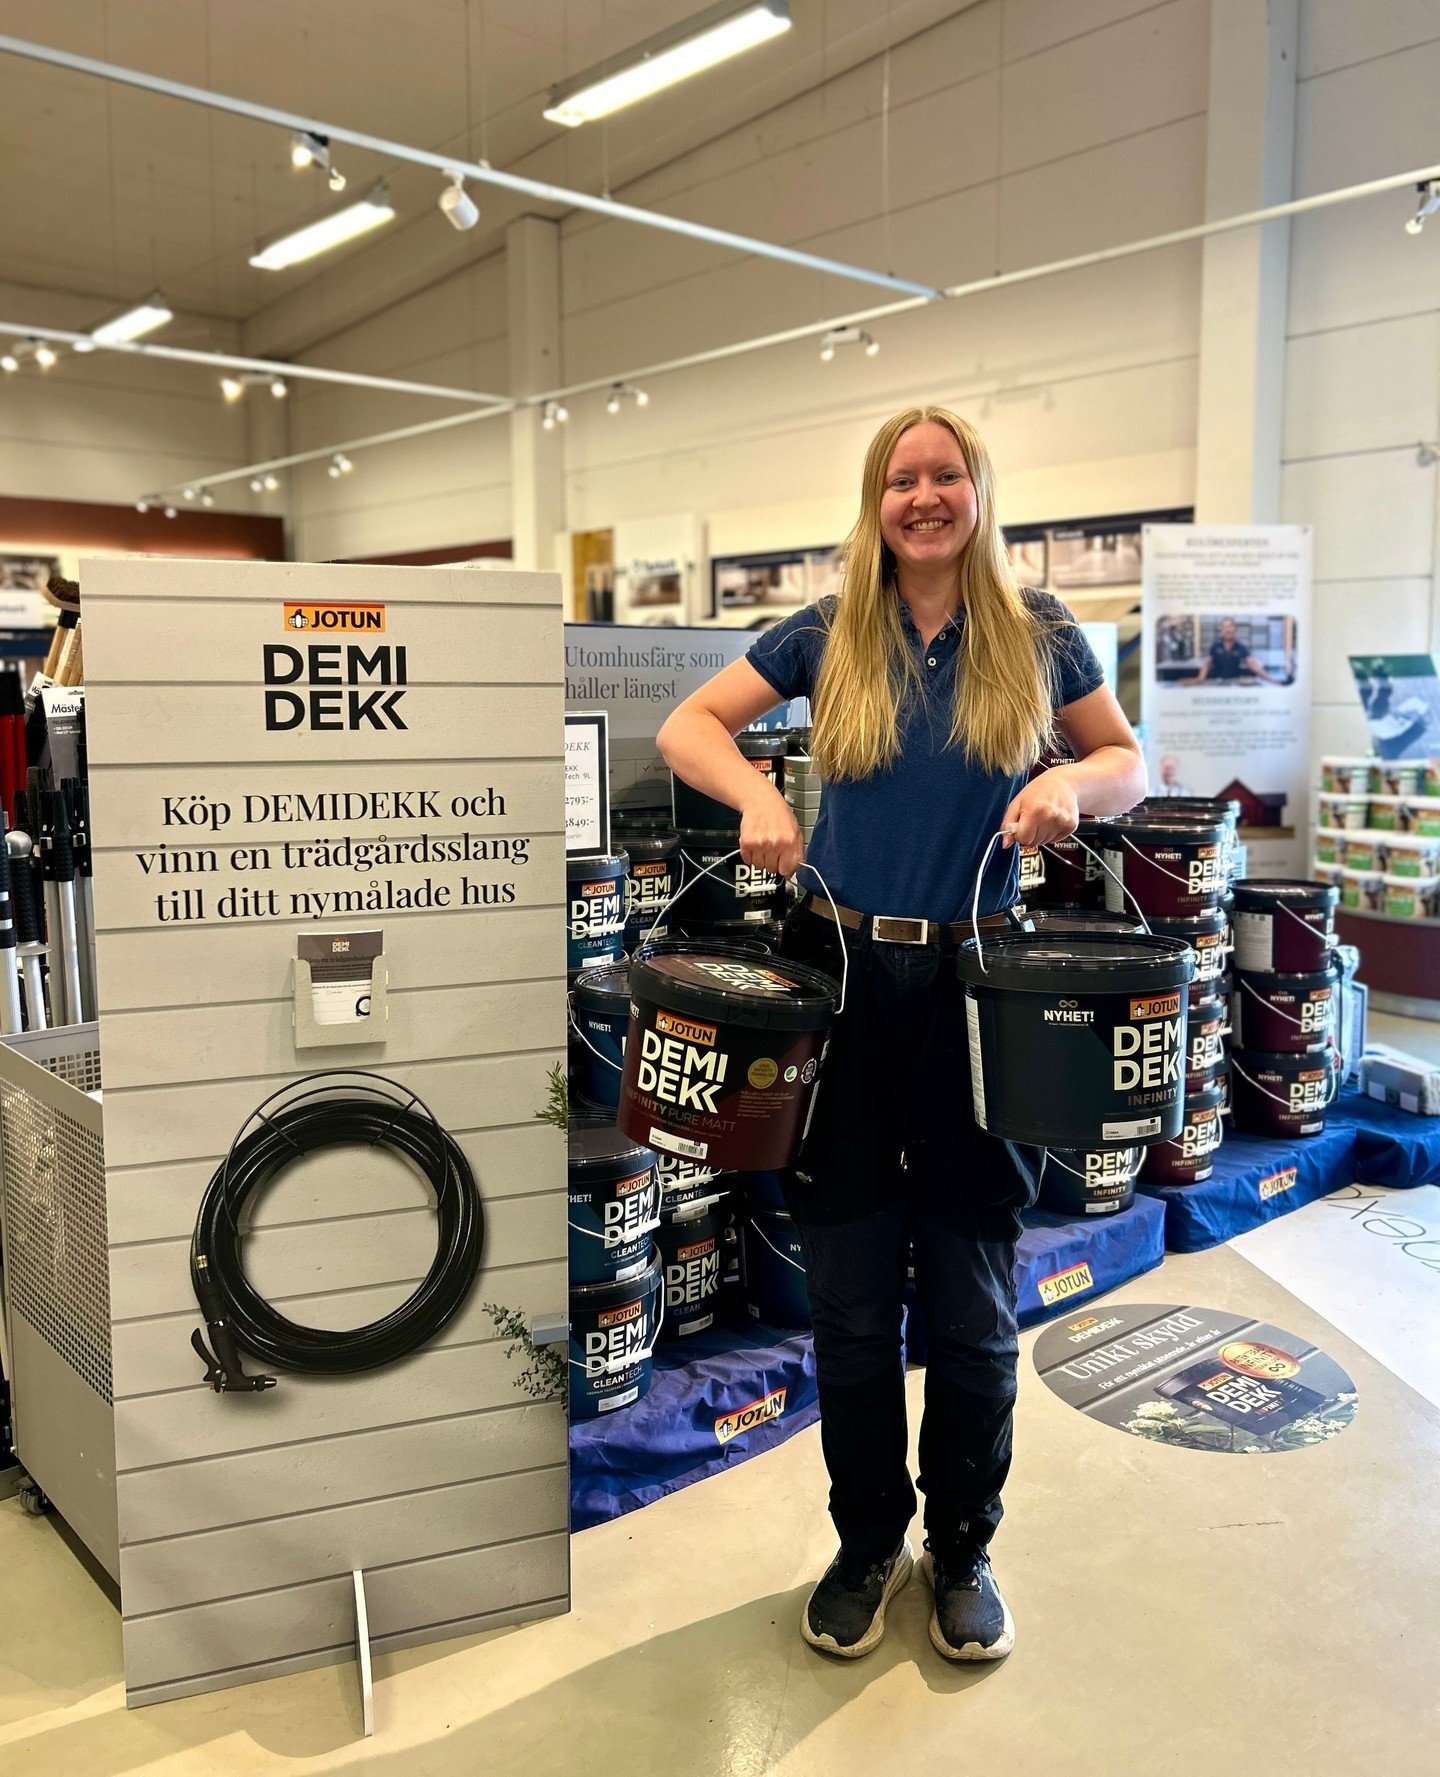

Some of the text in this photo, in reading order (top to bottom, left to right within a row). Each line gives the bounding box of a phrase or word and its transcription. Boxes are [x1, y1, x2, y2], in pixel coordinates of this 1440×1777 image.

[311, 611, 382, 629] JOTUN
[263, 644, 406, 686] DEMI
[565, 646, 724, 671] Utomhusfärg som
[565, 677, 619, 700] håller
[51, 703, 82, 713] Mäste
[265, 690, 408, 731] DEKK
[162, 788, 507, 830] Köp DEMIDEKK och
[136, 833, 530, 874] vinn en trädgårdsslang
[1154, 852, 1182, 860] NYHET!
[592, 883, 615, 895] JOTUN
[625, 875, 671, 897] DEMI
[155, 877, 515, 921] till ditt nymålade hus
[571, 895, 620, 920] DEMI
[1146, 998, 1179, 1016] JOTUN
[1270, 994, 1295, 1003] NYHET!
[588, 1020, 611, 1033] NYHET!
[1043, 1009, 1095, 1022] NYHET!
[669, 1020, 713, 1043] JOTUN
[1113, 1015, 1186, 1057] DEMI
[642, 1029, 729, 1083] DEMI
[637, 1059, 723, 1114] DEKK
[1258, 1074, 1283, 1082] NYHET!
[1127, 1086, 1178, 1107] INFINITY
[626, 1085, 668, 1115] INFINITY
[668, 1107, 700, 1126] PURE
[701, 1118, 736, 1132] MATT
[1085, 1147, 1134, 1171] DEMI
[1171, 1158, 1202, 1167] INFINITY
[627, 1175, 651, 1192] JOTUN
[1093, 1185, 1127, 1196] INFINITY
[1270, 1172, 1295, 1194] JOTUN
[604, 1183, 654, 1225] DEMI
[689, 1240, 714, 1258] JOTUN
[666, 1249, 720, 1286] DEMI
[666, 1271, 719, 1307] DEKK
[1054, 1269, 1091, 1297] JOTUN
[611, 1304, 640, 1324] JOTUN
[586, 1313, 648, 1355] DEMI
[1060, 1312, 1205, 1380] Unikt skydd
[592, 1366, 642, 1389] CLEANTECH
[1205, 1375, 1262, 1404] DEMI
[733, 1394, 783, 1432] JOTUN
